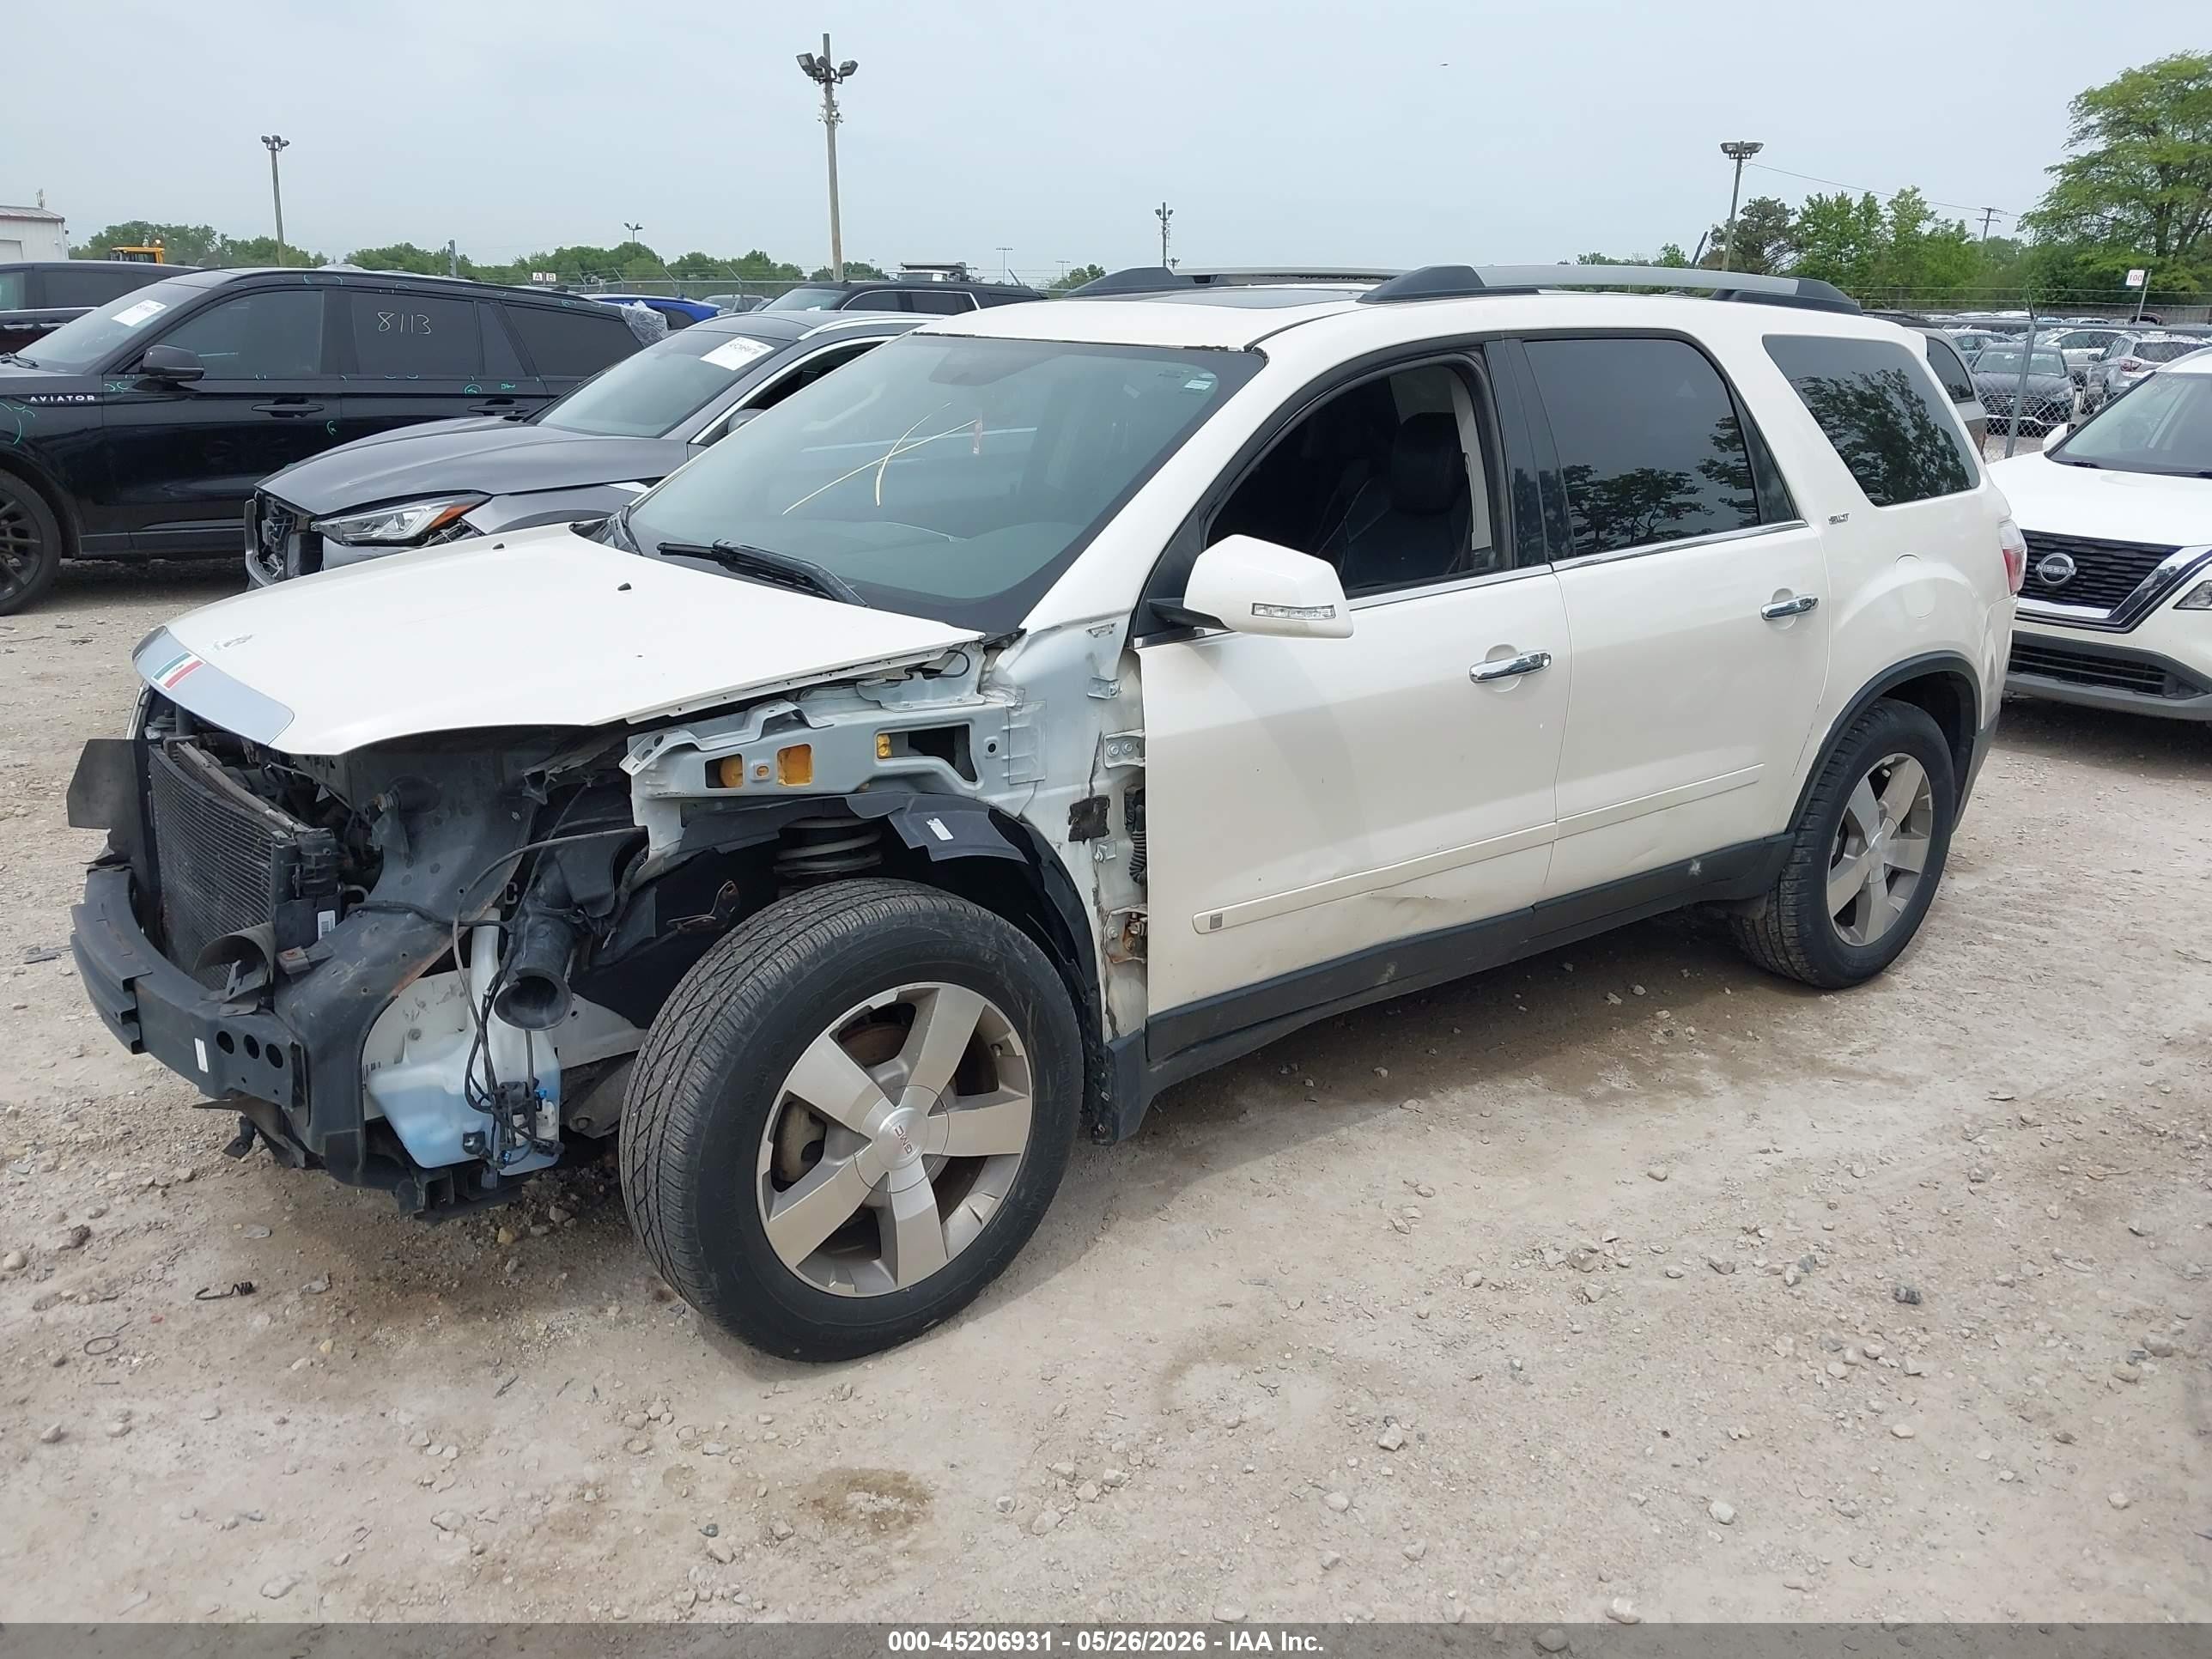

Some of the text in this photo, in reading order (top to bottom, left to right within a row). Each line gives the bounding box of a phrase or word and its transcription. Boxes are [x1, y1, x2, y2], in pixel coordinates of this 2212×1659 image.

[377, 312, 431, 335] 8113
[2035, 562, 2078, 575] NISSAN
[894, 1124, 913, 1155] GMC
